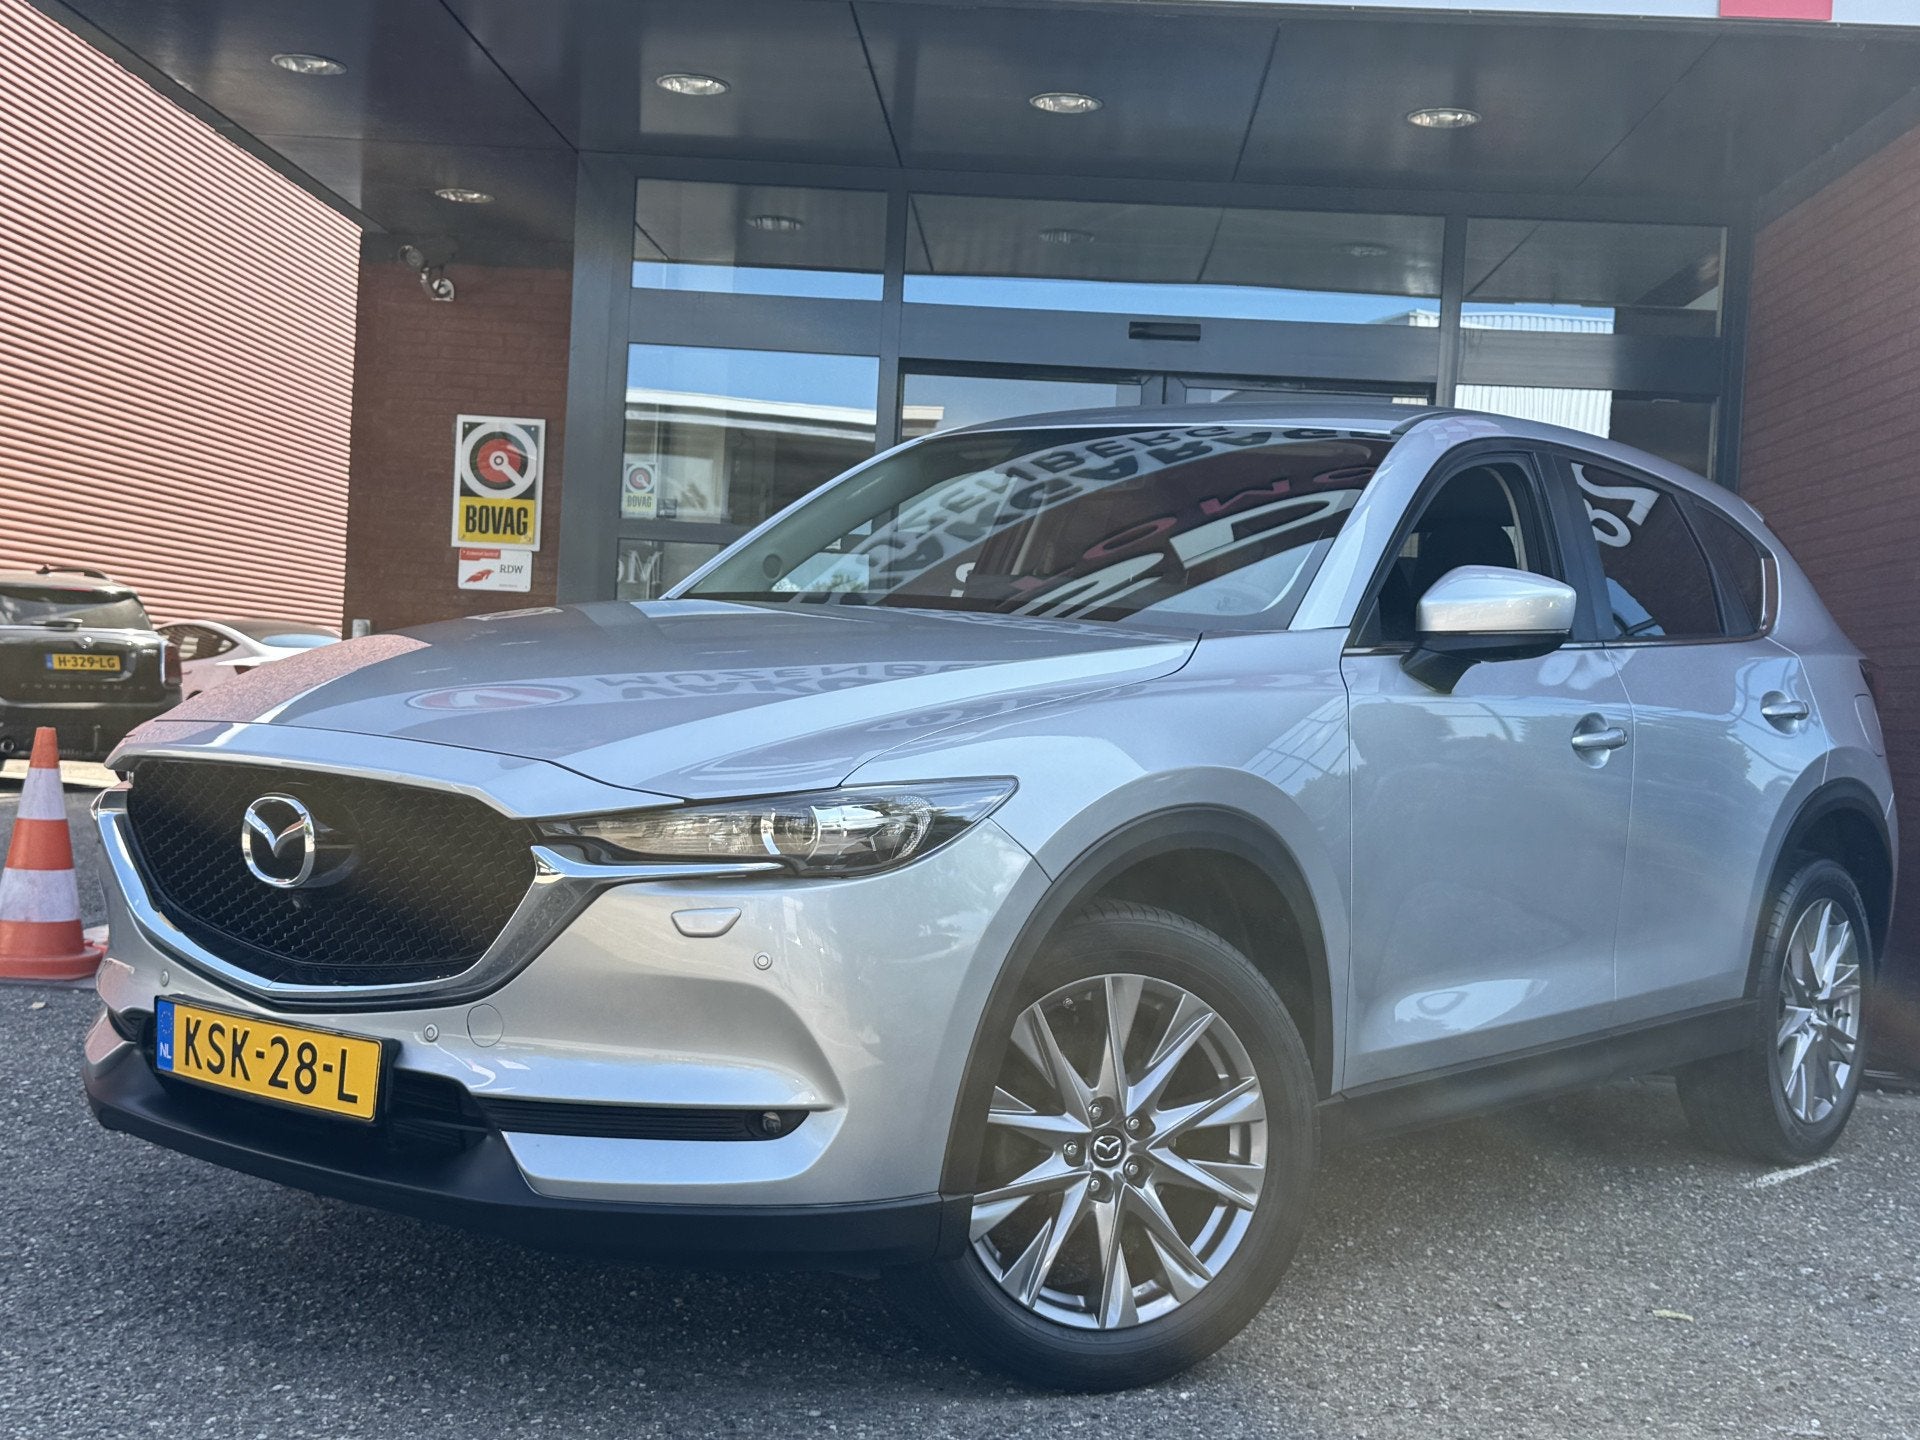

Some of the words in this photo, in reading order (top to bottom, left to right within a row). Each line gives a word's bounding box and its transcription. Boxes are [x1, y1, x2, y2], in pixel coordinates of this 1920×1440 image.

[627, 495, 652, 508] BOVAG
[465, 504, 528, 536] BOVAG
[500, 564, 523, 574] RDW
[58, 655, 116, 668] H-329-LG
[159, 1042, 172, 1060] NL
[184, 1015, 358, 1104] KSK-28-L
